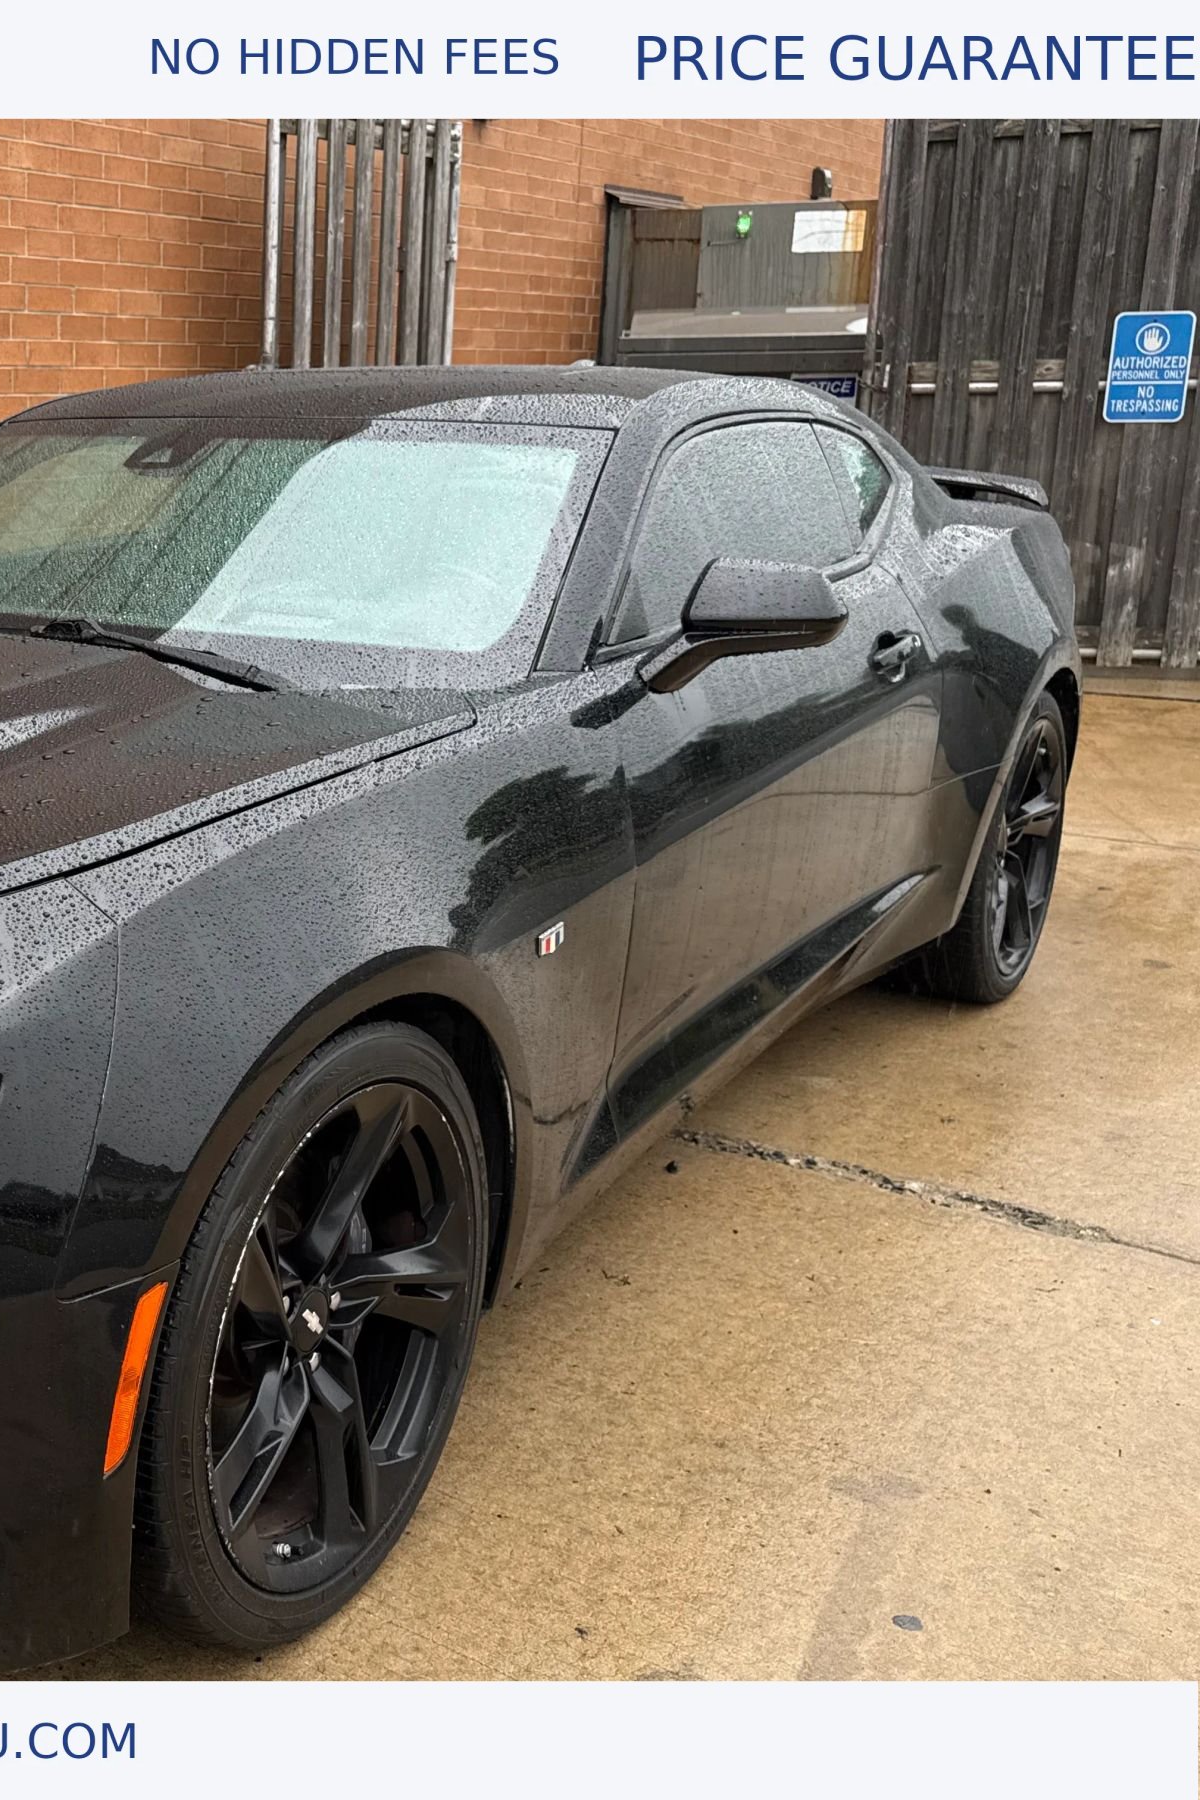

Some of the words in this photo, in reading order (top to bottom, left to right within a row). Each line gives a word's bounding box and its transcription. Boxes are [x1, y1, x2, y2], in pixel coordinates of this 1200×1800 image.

[1113, 356, 1187, 369] AUTHORIZED
[1111, 370, 1159, 380] PERSONNEL
[1164, 369, 1186, 379] ONLY
[808, 381, 853, 393] TICE
[1137, 385, 1155, 398] NO
[1110, 399, 1179, 412] TRESPASSING
